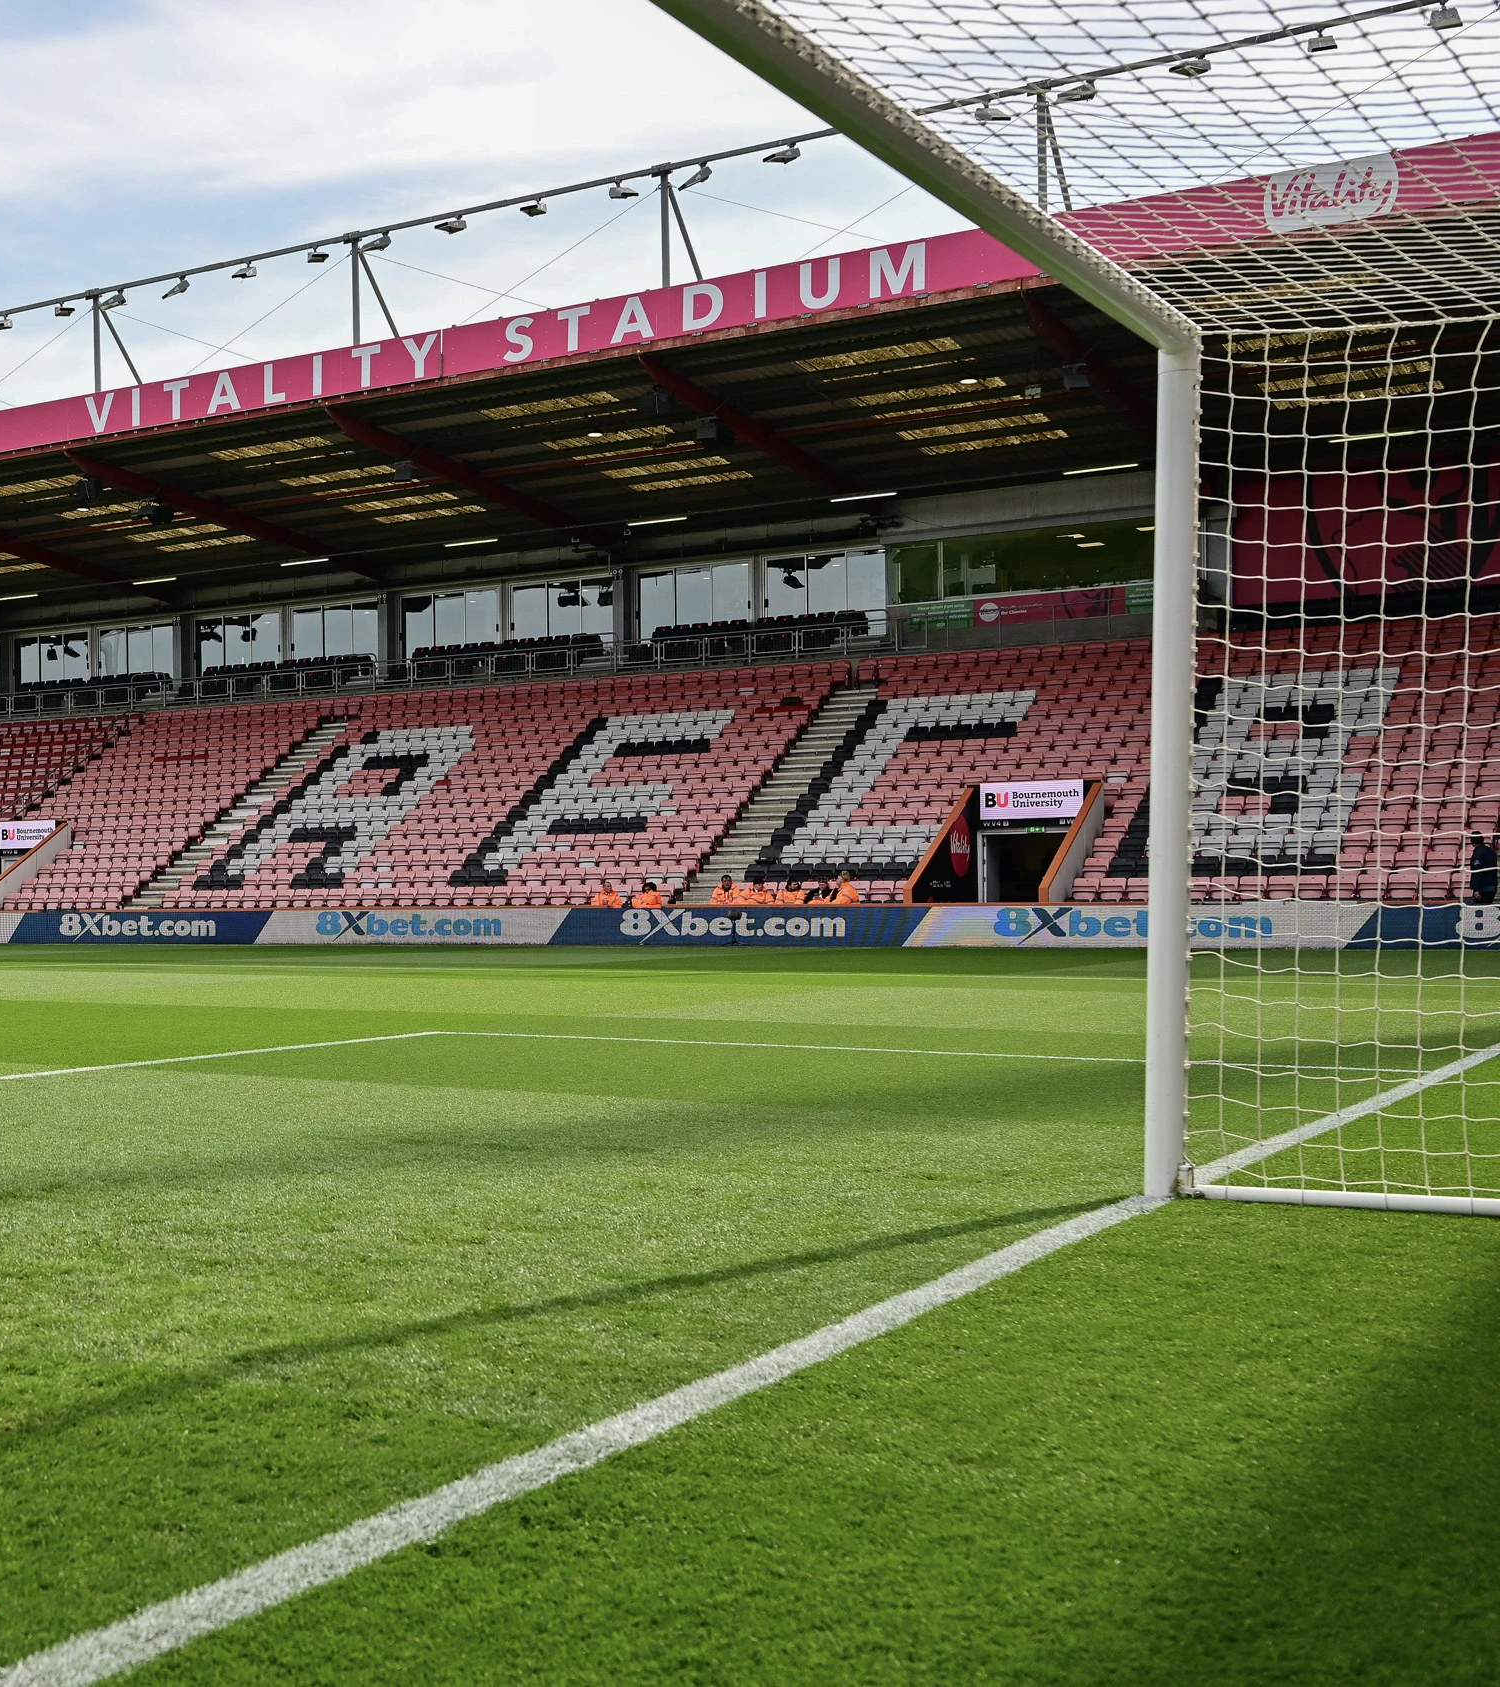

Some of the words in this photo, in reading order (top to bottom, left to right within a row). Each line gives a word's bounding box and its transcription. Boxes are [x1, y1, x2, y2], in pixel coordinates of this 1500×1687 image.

[1271, 166, 1394, 218] Vitality
[84, 333, 437, 434] VITALITY
[502, 241, 926, 363] STADIUM
[984, 791, 1009, 808] BU
[1012, 788, 1080, 799] Bournemouth
[1012, 798, 1064, 809] University
[16, 826, 54, 835] Bournemouth
[16, 833, 46, 842] University
[949, 830, 971, 860] Vitality
[59, 912, 216, 942] 8Xbet.com
[315, 911, 502, 941] 8Xbet.com
[619, 908, 846, 945] 8Xbet.com
